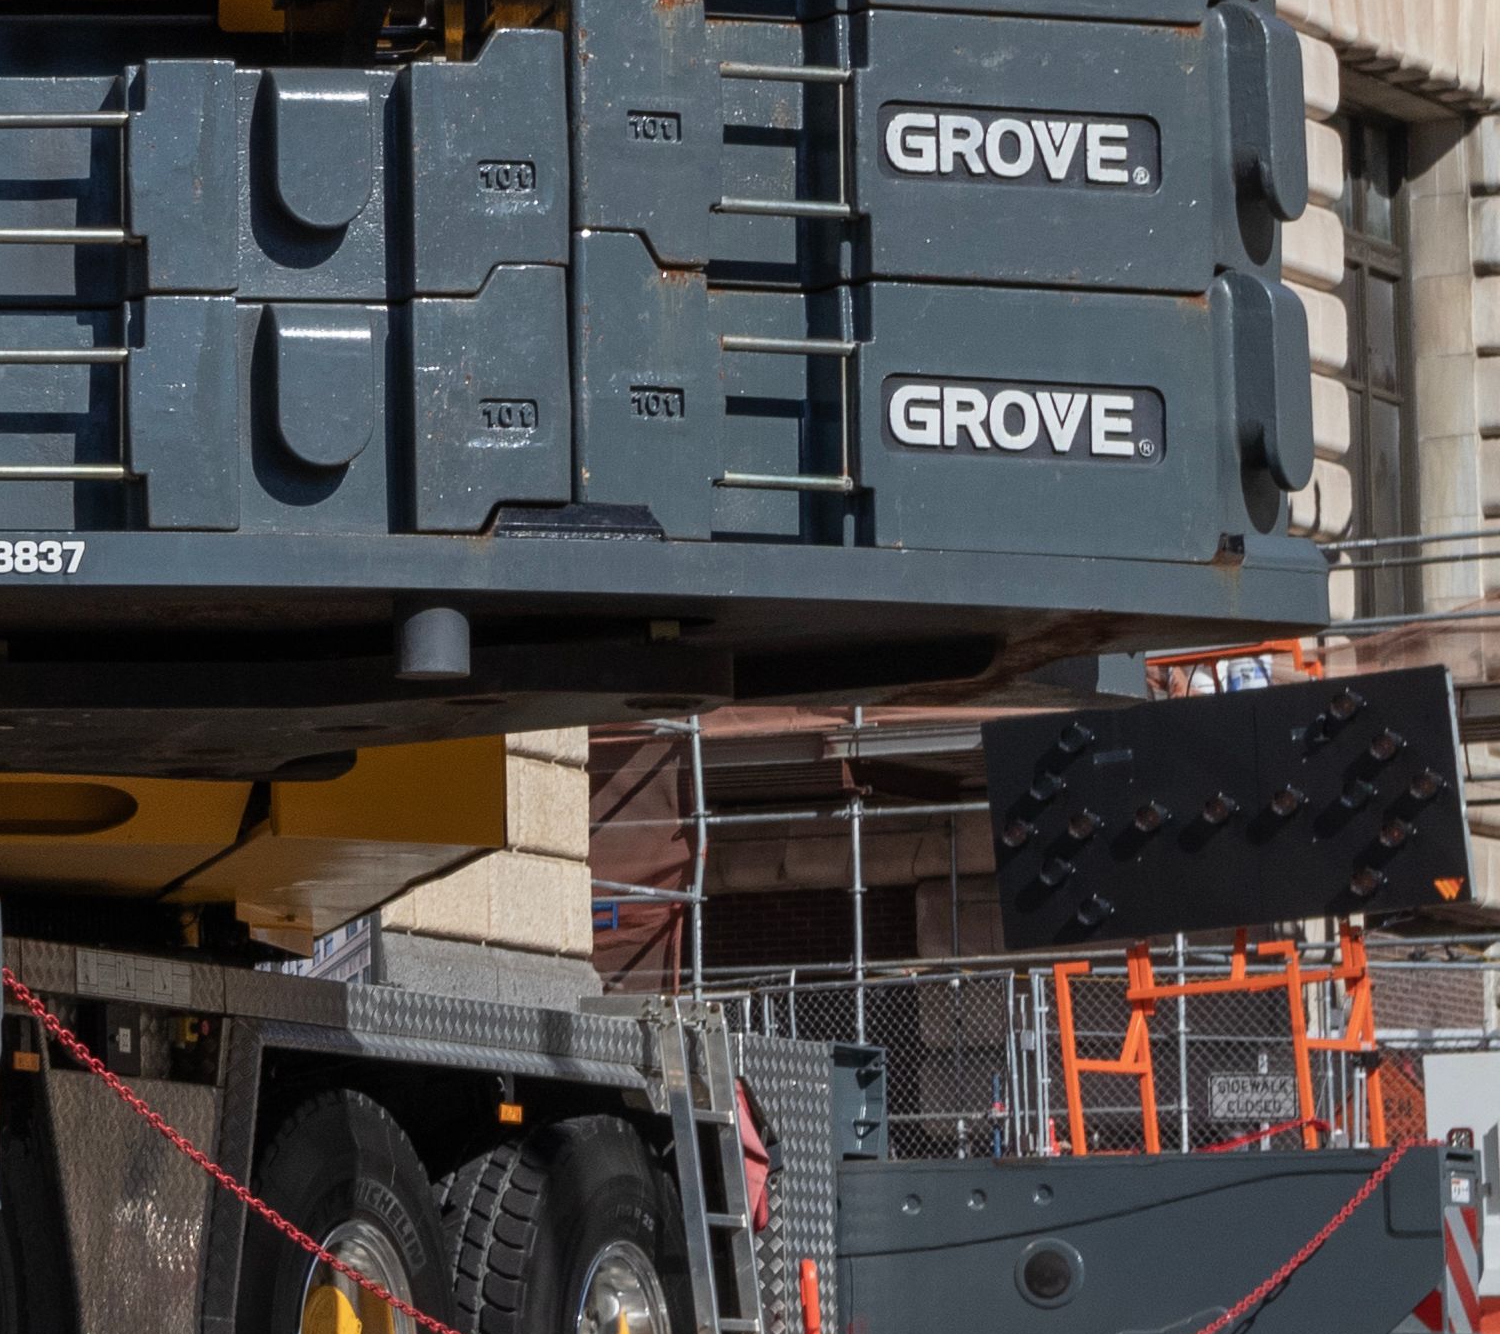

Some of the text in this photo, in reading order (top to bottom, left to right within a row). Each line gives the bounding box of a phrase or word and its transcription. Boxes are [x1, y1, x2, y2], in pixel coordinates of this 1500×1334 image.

[885, 112, 1130, 184] GROVE
[889, 385, 1135, 456] GROVE
[1216, 1078, 1289, 1094] SIDEWALK
[1227, 1100, 1282, 1113] CLOSED
